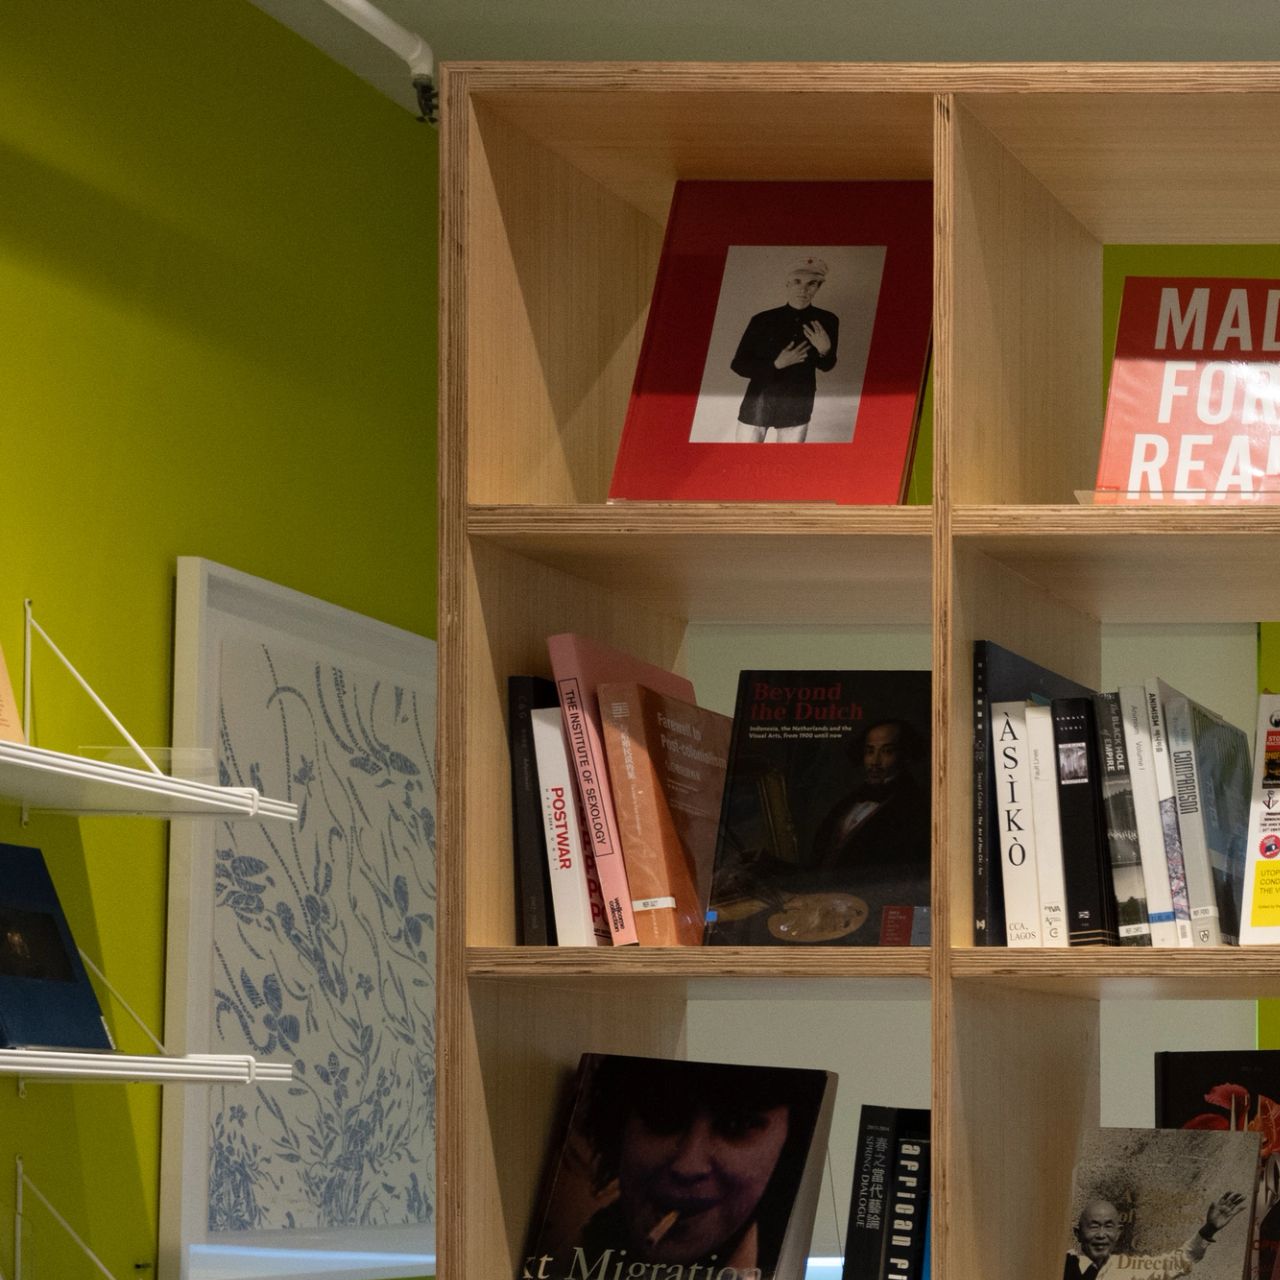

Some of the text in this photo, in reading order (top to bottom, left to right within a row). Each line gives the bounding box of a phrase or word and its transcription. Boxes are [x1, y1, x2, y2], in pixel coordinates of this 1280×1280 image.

[751, 701, 864, 721] the Dutch
[754, 682, 842, 702] Beyond
[1149, 693, 1161, 732] ANIMISM
[565, 689, 607, 845] THE INSTITUTE OF SEXOLOGY
[1000, 712, 1026, 866] ÀSÌKÒ
[1173, 750, 1199, 815] COMPARISON
[551, 787, 572, 870] POSTWAR
[1010, 931, 1036, 940] LAGOS
